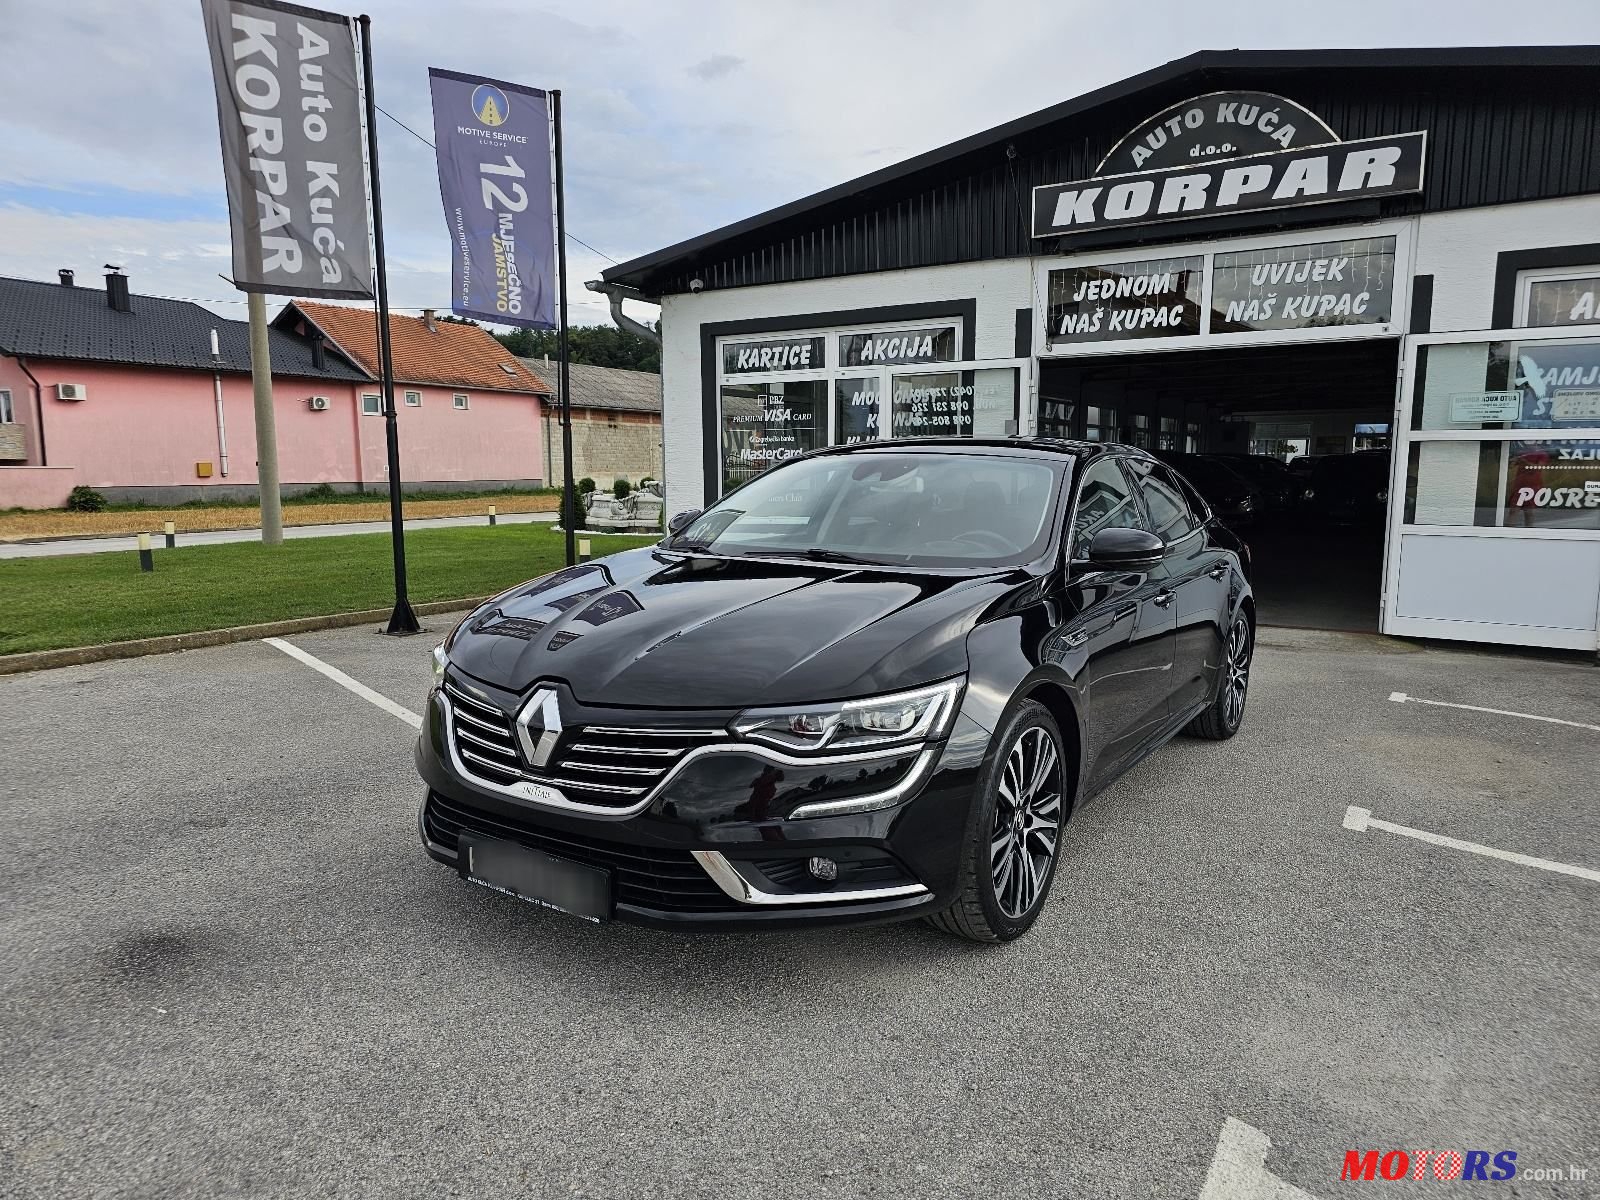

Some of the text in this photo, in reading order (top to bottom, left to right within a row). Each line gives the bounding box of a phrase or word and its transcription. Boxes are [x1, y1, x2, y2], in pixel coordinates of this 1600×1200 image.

[231, 13, 304, 276] KORPAR
[457, 125, 528, 144] MOTIVE SERVICE
[479, 139, 508, 148] EUROPE
[1130, 102, 1297, 168] AUTO KUĆA
[296, 22, 346, 285] Auto Kuća
[1189, 142, 1238, 159] d.o.o.
[479, 155, 529, 213] 12
[1051, 146, 1402, 228] KORPAR
[455, 207, 471, 307] www.motiveservice.eu
[491, 232, 508, 313] JAMSTVO
[498, 213, 523, 315] MJESEČNO
[1252, 256, 1350, 287] UVIJEK
[1073, 272, 1171, 303] JEDNOM
[1060, 304, 1184, 336] NAŠ KUPAC
[1225, 291, 1371, 323] NAŠ KUPAC
[1569, 291, 1600, 320] A
[737, 344, 812, 370] KARTICE
[860, 335, 934, 361] AKCIJA
[733, 408, 812, 423] PREMIUM VISA CARD
[769, 395, 785, 405] PBZ
[740, 447, 804, 461] MasterCard
